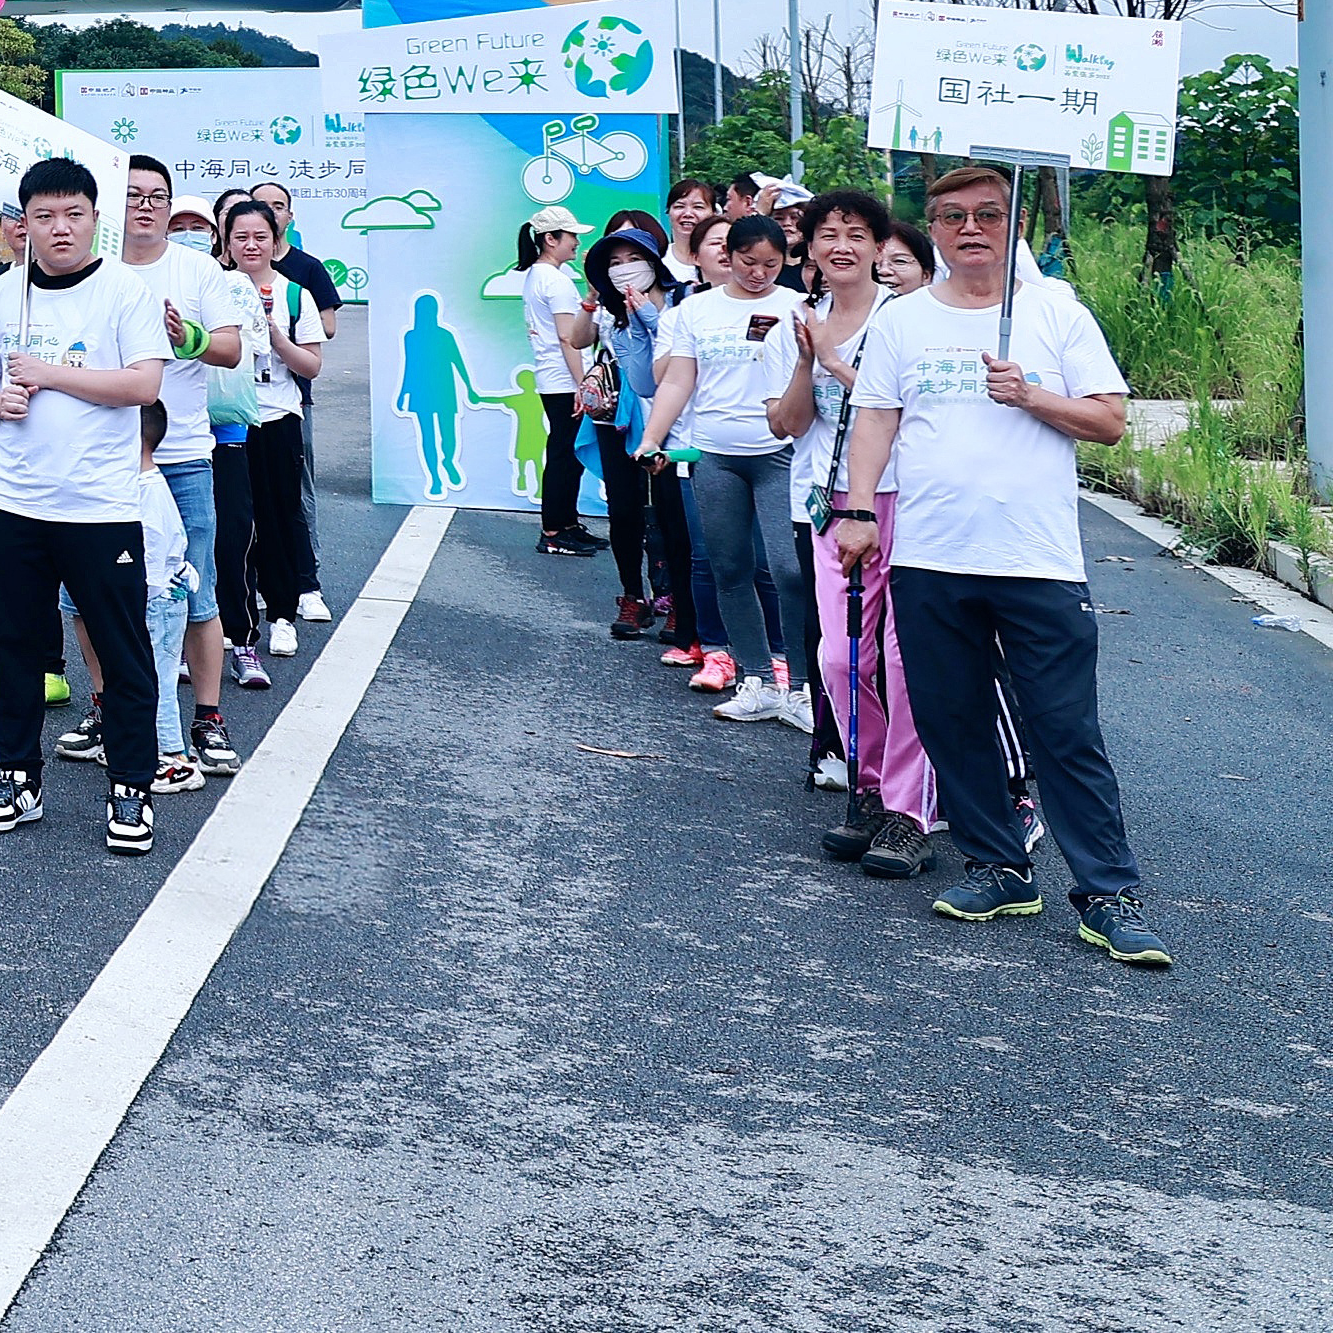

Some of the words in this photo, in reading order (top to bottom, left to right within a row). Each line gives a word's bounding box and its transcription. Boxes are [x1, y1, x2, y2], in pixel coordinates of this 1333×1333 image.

[406, 35, 469, 56] Green
[476, 29, 545, 51] Future
[357, 57, 550, 103] 绿色We来
[938, 76, 1099, 115] 国社一期
[175, 159, 281, 181] 中海同心
